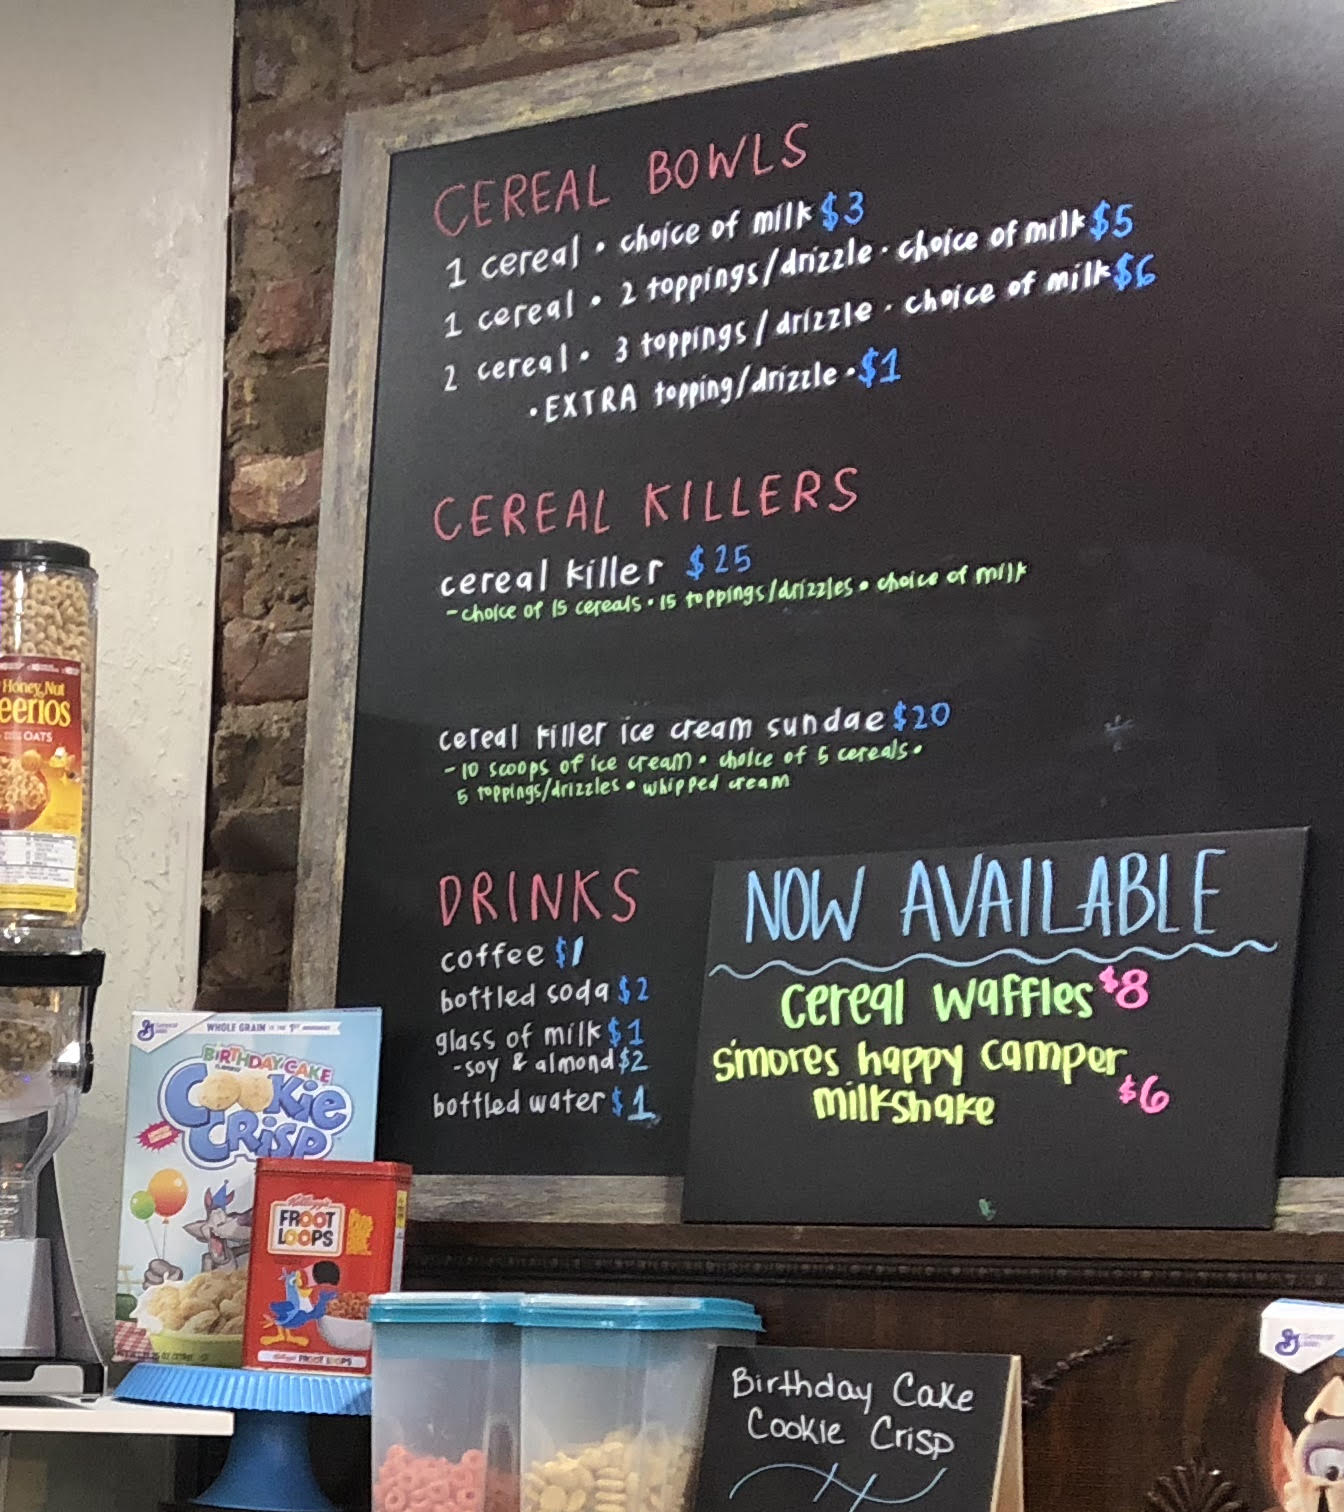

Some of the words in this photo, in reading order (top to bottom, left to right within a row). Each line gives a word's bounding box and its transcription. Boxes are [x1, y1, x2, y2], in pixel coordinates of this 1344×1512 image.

[433, 164, 610, 237] CEREAL
[648, 123, 808, 195] BOWLS
[446, 258, 466, 288] 1
[481, 234, 579, 279] cereal
[620, 223, 700, 253] choice
[712, 210, 741, 239] of
[753, 201, 812, 234] milk
[821, 191, 864, 232] $3
[444, 313, 462, 338] 1
[478, 289, 573, 330] cereal
[622, 283, 636, 306] 2
[899, 230, 978, 262] choice
[991, 220, 1018, 247] of
[1025, 210, 1085, 243] milk
[1089, 200, 1134, 242] $5
[444, 366, 457, 391] 2
[478, 344, 566, 381] cereal
[615, 338, 627, 363] 3
[906, 286, 995, 315] choice
[1008, 270, 1037, 296] of
[1048, 259, 1110, 292] milk
[1114, 252, 1156, 290] $6
[433, 488, 611, 542] CEREAL
[645, 466, 860, 528] KILLERS
[441, 559, 548, 596] cereal
[566, 555, 664, 589] killer
[686, 544, 752, 581] $25
[524, 601, 544, 620] of
[552, 599, 568, 617] 15
[575, 594, 642, 616] cereals
[661, 591, 676, 610] 15
[878, 571, 938, 592] choice
[946, 564, 968, 584] of
[976, 561, 1028, 584] milk
[2, 679, 42, 697] Honey
[45, 680, 65, 697] Nut
[23, 732, 53, 742] OATS
[440, 724, 517, 750] cereal
[537, 721, 608, 750] killer
[622, 716, 654, 744] ice
[671, 717, 752, 741] cream
[767, 707, 884, 738] sundae
[893, 700, 950, 732] $20
[489, 759, 549, 781] scoops
[561, 754, 584, 774] of
[592, 754, 617, 772] ice
[628, 752, 692, 772] cream
[720, 747, 773, 769] choice
[784, 745, 808, 764] of
[818, 745, 828, 765] 5
[838, 739, 908, 763] cereals
[457, 789, 468, 805] 5
[643, 774, 718, 797] whipped
[728, 774, 789, 791] cream
[440, 869, 639, 926] DRINKS
[744, 866, 867, 943] NOW
[901, 848, 1228, 937] AVAILABLE
[441, 942, 544, 972] coffee
[556, 936, 584, 968] $1
[441, 983, 535, 1014] bottled
[547, 979, 609, 1006] soda
[618, 975, 649, 1004] $2
[1099, 966, 1151, 1010] $8
[207, 1023, 237, 1032] WHOLE
[239, 1023, 265, 1032] GRAIN
[436, 1029, 495, 1055] glass
[506, 1022, 533, 1048] of
[545, 1020, 601, 1047] milk
[608, 1017, 645, 1047] $1
[284, 1059, 332, 1083] CAKE
[513, 1052, 527, 1071] &
[535, 1048, 614, 1074] almond
[619, 1047, 648, 1075] $2
[857, 1041, 964, 1085] happy
[981, 1037, 1128, 1085] camper
[434, 1089, 519, 1119] bottled
[530, 1089, 606, 1114] water
[612, 1085, 657, 1120] $1
[813, 1081, 996, 1125] milkshake
[1119, 1075, 1171, 1115] $6
[278, 1230, 333, 1247] LOOPS
[280, 1210, 335, 1228] FROOT
[731, 1367, 873, 1412] Birthday
[892, 1373, 974, 1412] Cake
[747, 1407, 845, 1446] Cookie
[870, 1419, 955, 1458] Crisp
